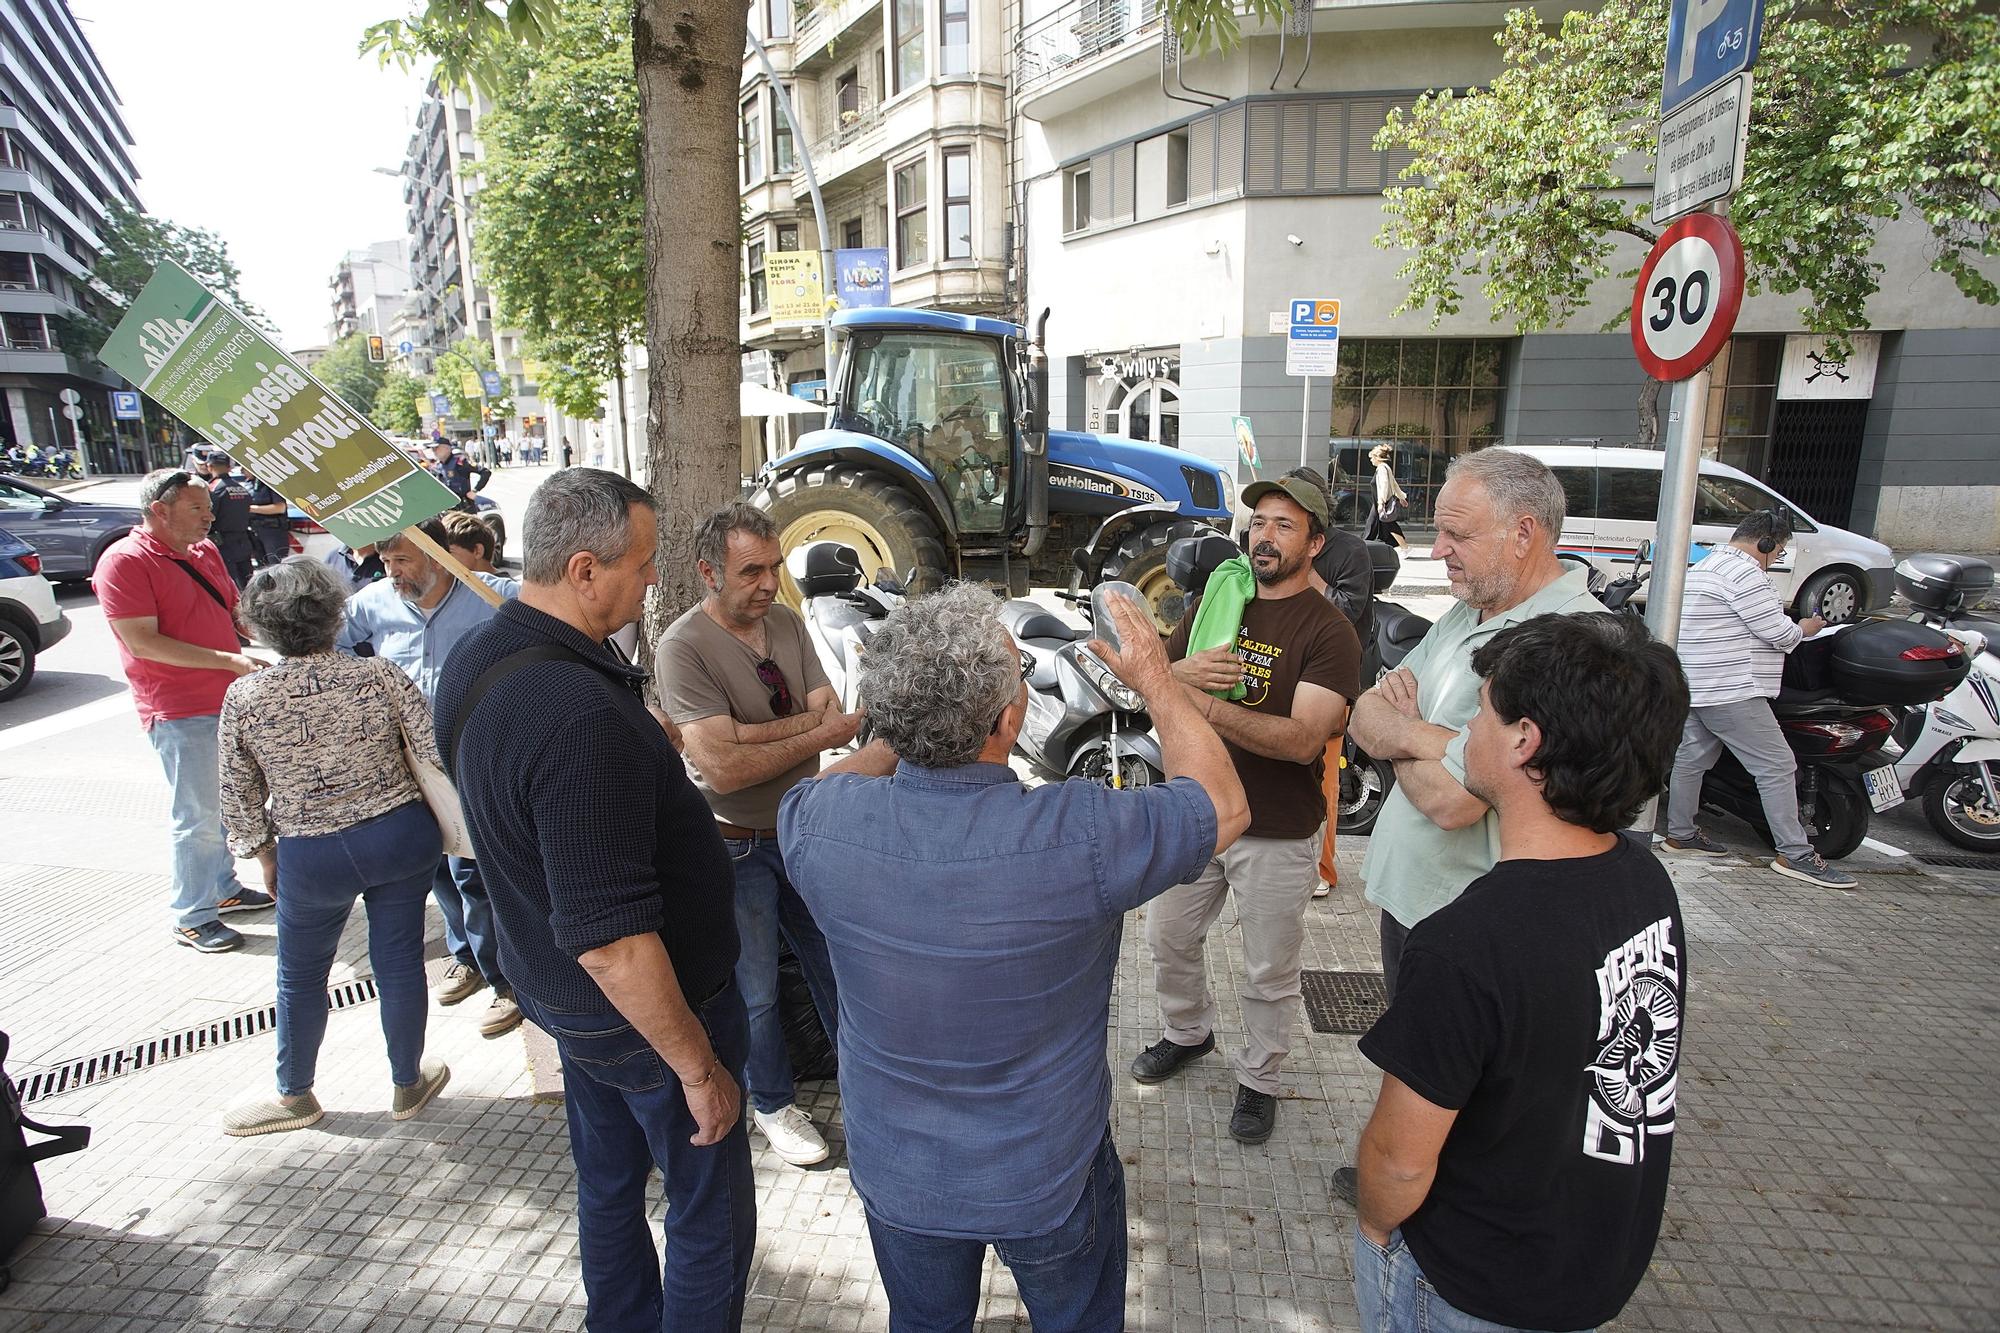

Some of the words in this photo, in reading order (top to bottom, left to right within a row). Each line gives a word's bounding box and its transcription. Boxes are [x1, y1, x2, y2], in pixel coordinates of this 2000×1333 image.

[1707, 106, 1714, 122] de
[1689, 149, 1695, 163] de
[843, 267, 884, 283] MAR
[1649, 269, 1710, 332] 30
[1296, 304, 1311, 322] P
[196, 330, 216, 351] sector
[212, 311, 233, 335] agrari
[172, 374, 208, 406] inacció
[196, 361, 223, 383] dels
[214, 329, 254, 371] governs
[118, 395, 134, 410] P
[198, 423, 242, 451] La
[222, 362, 310, 442] pagesia
[1089, 404, 1100, 430] Bar
[244, 447, 300, 486] diu
[280, 395, 361, 473] prou!
[1047, 475, 1114, 495] ewHolland
[1131, 488, 1155, 502] TS135
[1240, 625, 1249, 637] A
[1249, 653, 1274, 667] FEM
[1931, 727, 1952, 736] YAMAHA
[1871, 767, 1894, 788] 8111
[1878, 783, 1896, 802] HYY
